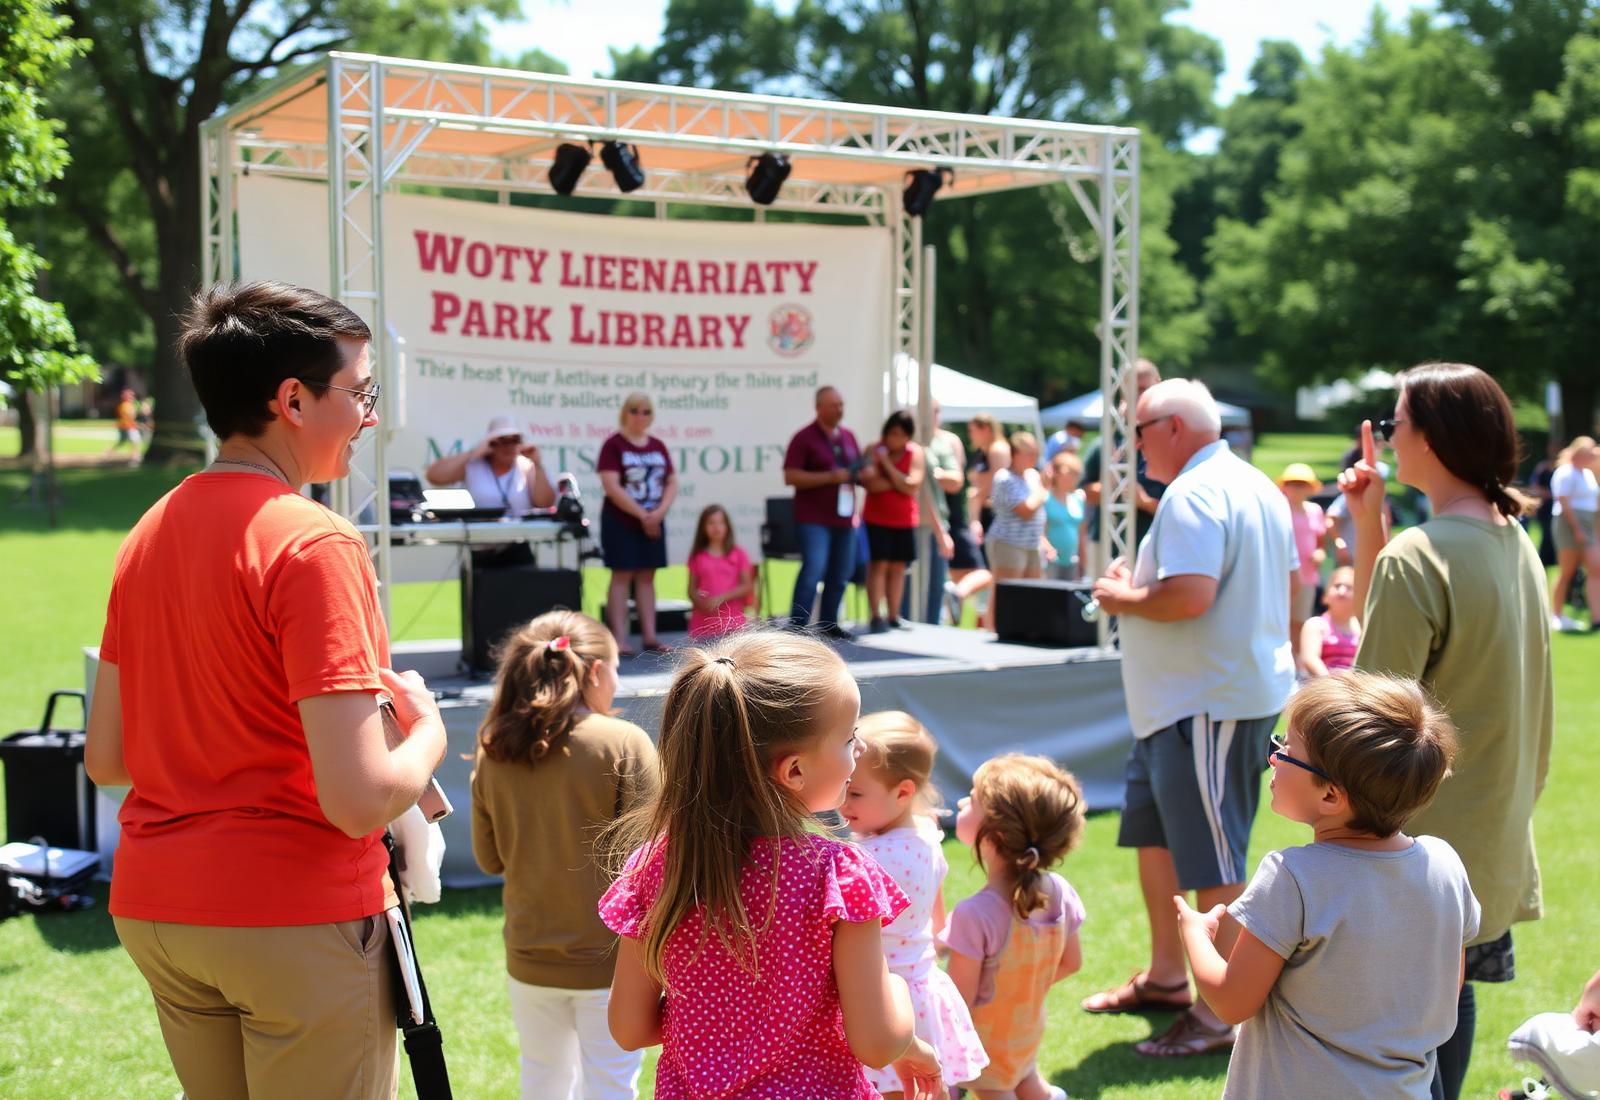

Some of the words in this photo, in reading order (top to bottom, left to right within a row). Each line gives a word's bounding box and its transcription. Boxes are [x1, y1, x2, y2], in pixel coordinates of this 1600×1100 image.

[413, 228, 549, 284] WOTY
[560, 251, 818, 294] LIEENARIATY
[430, 290, 552, 343] PARK
[569, 302, 752, 349] LIBRARY
